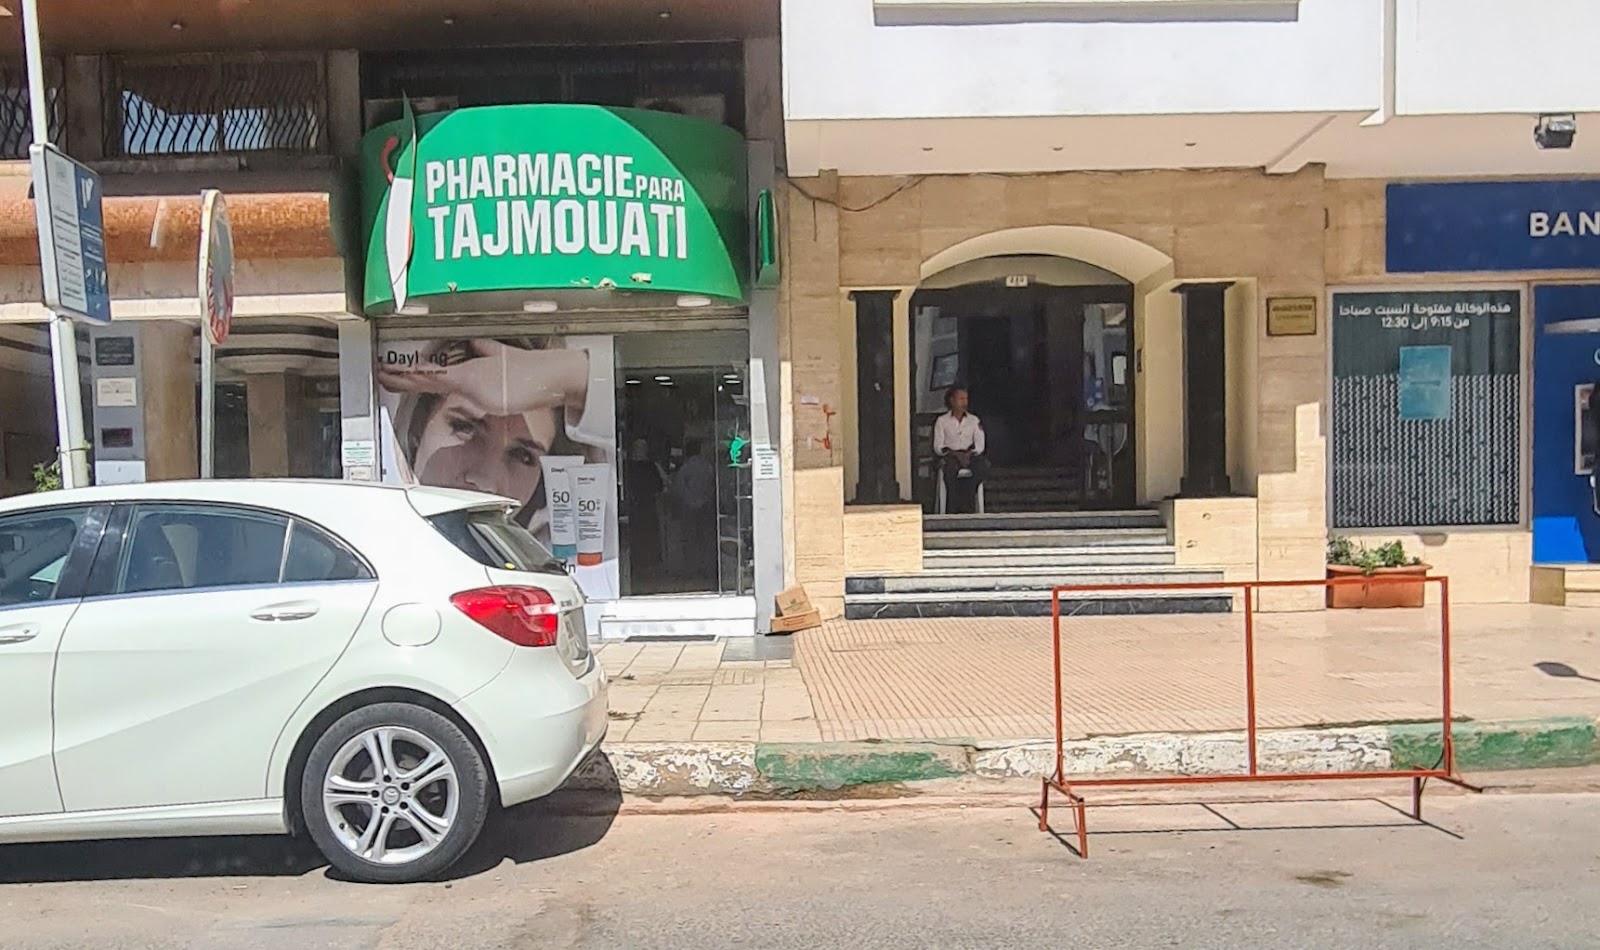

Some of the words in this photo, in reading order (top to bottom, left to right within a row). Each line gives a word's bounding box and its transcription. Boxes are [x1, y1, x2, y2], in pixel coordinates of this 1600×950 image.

[426, 153, 634, 204] PHARMACIE
[635, 174, 686, 202] PARA
[427, 199, 688, 260] TAJMOUATI
[1530, 211, 1600, 237] BAN
[1374, 303, 1410, 315] السبت
[1413, 303, 1453, 317] مفتوحة
[1454, 302, 1490, 317] الوكالة
[1490, 302, 1512, 314] هذه
[1453, 317, 1470, 330] من
[552, 491, 570, 504] 50
